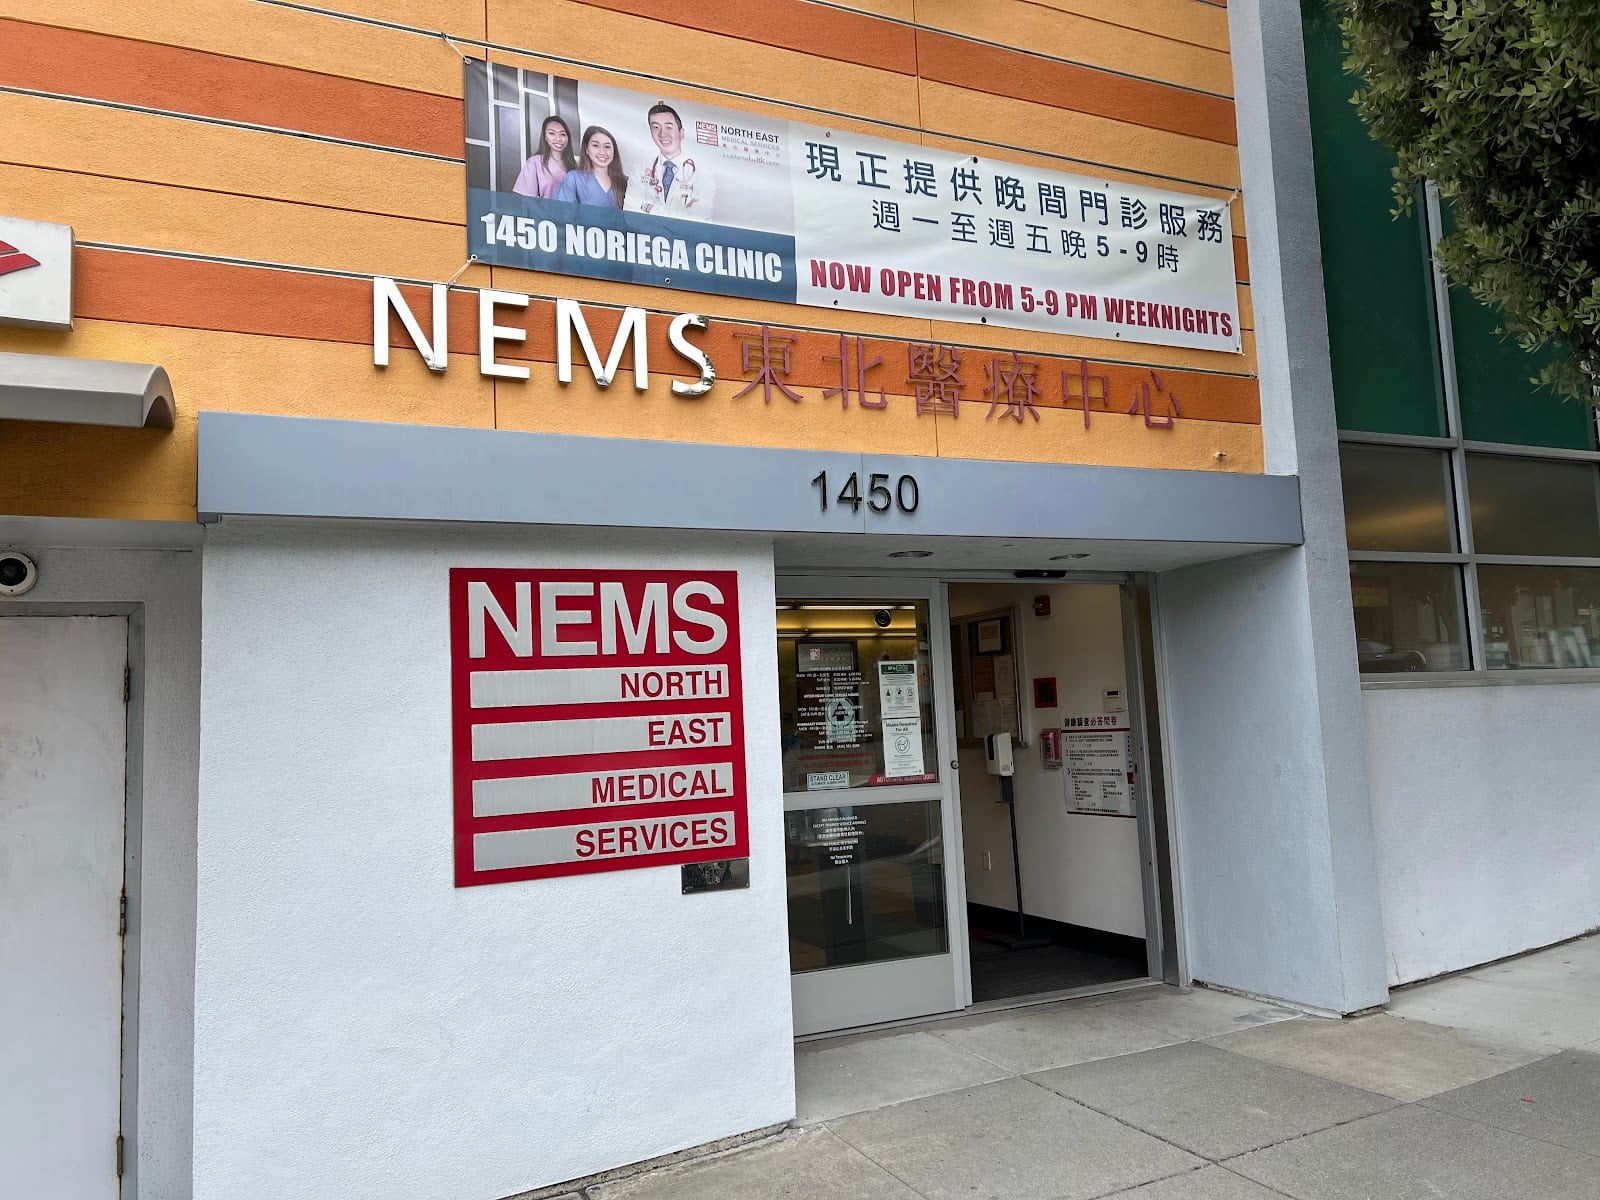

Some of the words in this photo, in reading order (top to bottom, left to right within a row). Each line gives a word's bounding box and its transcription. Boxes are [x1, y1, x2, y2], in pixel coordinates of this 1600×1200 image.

[697, 122, 717, 132] NEMS
[721, 126, 753, 139] NORTH
[756, 132, 779, 143] EAST
[722, 136, 749, 146] MEDICAL
[750, 141, 780, 151] SERVICES
[805, 141, 1223, 244] 現正提供晚間門診服務
[480, 212, 557, 254] 1450
[565, 223, 690, 271] NORIEGA
[695, 242, 783, 283] CLINIC
[872, 199, 1179, 273] 週一至週五晚5-9時
[810, 259, 871, 293] NOW
[880, 267, 942, 302] OPEN
[950, 277, 1014, 311] FROM
[1021, 286, 1060, 316] 5-9
[1065, 290, 1098, 320] PM
[1103, 296, 1233, 338] WEEKNIGHTS
[373, 276, 717, 396] NEMS
[732, 324, 1182, 430] 東北醫療中心
[811, 470, 919, 513] 1450
[467, 580, 728, 659] NEMS
[620, 670, 722, 698] NORTH
[648, 717, 724, 747] EAST
[591, 769, 727, 804] MEDICAL
[810, 775, 827, 783] STAND
[828, 773, 846, 781] CLEAR
[575, 817, 728, 857] SERVICES
